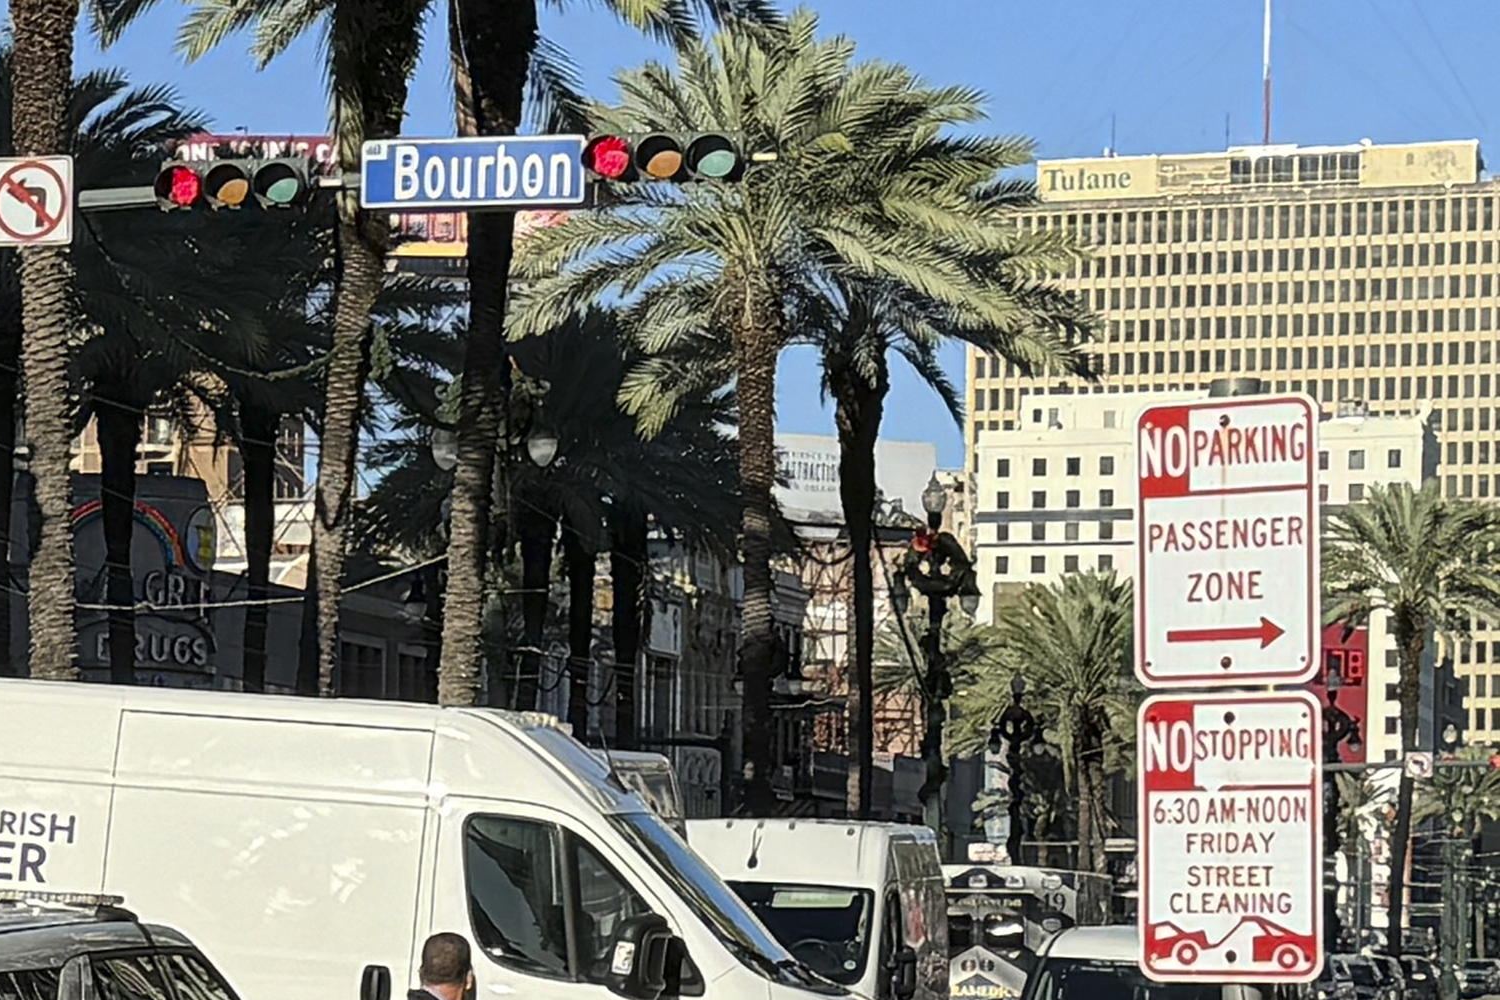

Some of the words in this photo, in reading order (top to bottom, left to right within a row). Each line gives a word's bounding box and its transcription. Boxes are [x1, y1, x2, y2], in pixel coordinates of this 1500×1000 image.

[394, 145, 572, 200] Bourbon
[1043, 167, 1132, 192] Tulane
[1141, 424, 1188, 478] NO
[1193, 423, 1306, 468] PARKING
[1148, 516, 1304, 554] PASSENGER
[1187, 570, 1264, 603] ZONE
[1145, 720, 1193, 773] NO
[1195, 728, 1309, 761] STOPPING
[1153, 798, 1200, 825] 6:30
[1205, 796, 1308, 825] AM-NOON
[1185, 831, 1276, 854] FRIDAY
[1187, 865, 1274, 887] STREET
[1169, 892, 1293, 915] CLEANING
